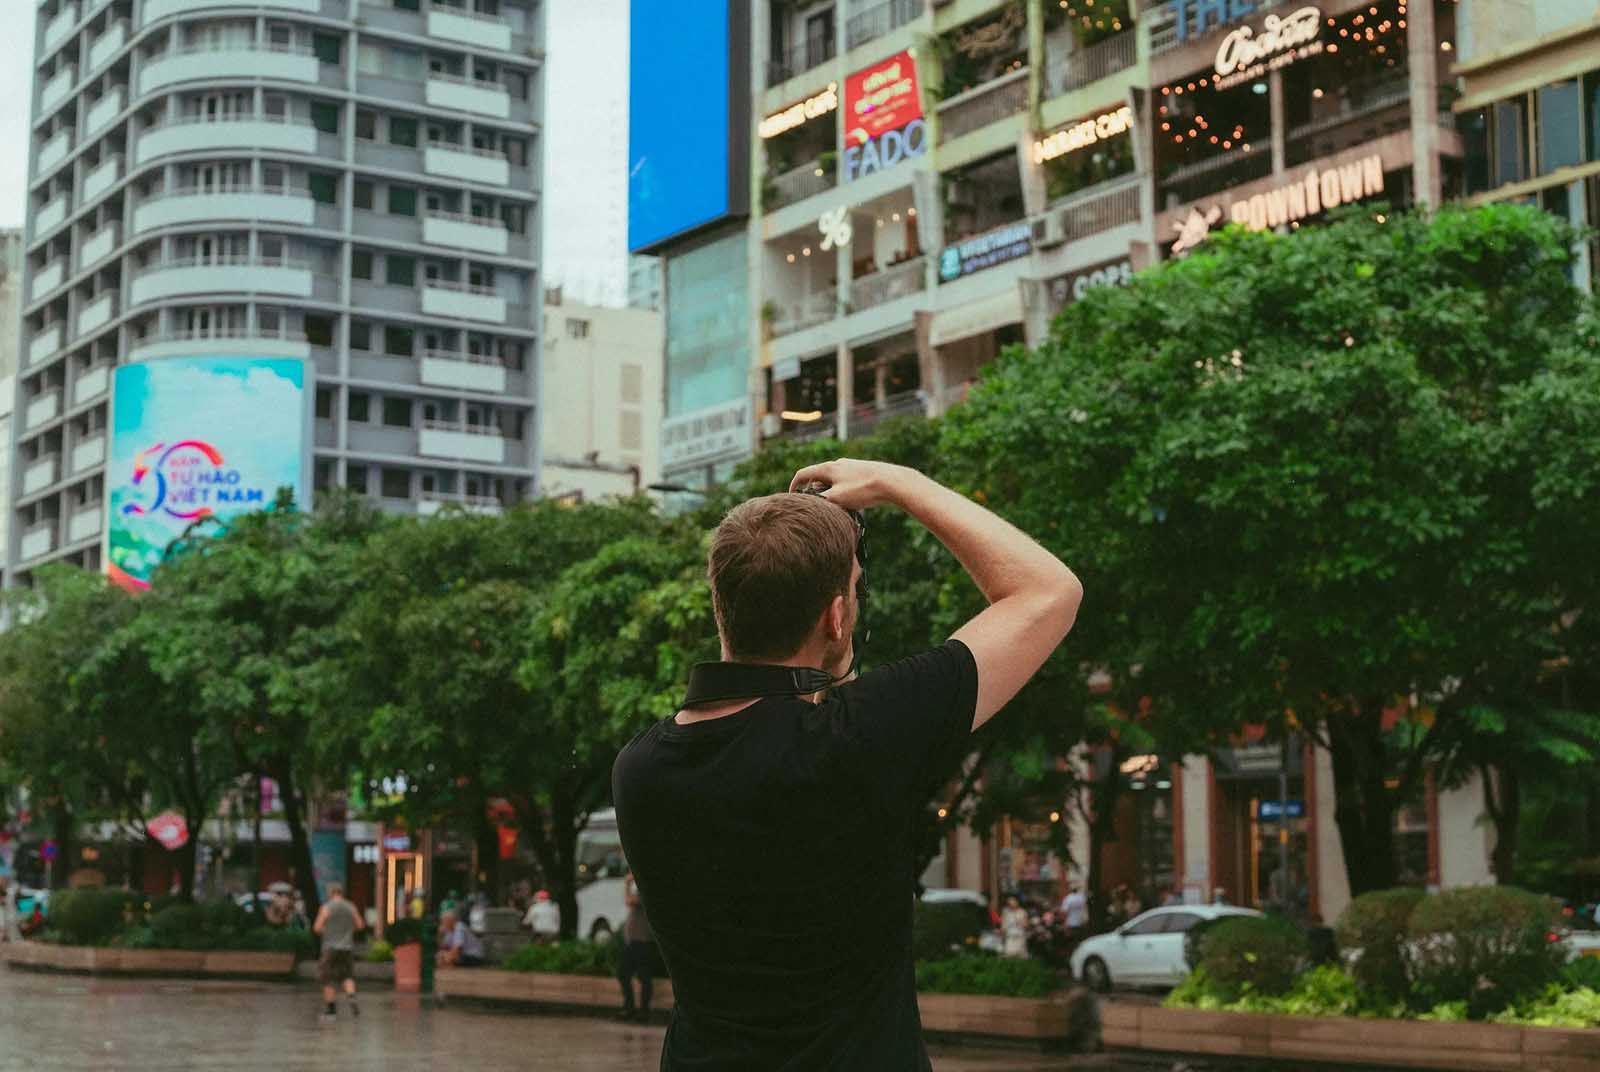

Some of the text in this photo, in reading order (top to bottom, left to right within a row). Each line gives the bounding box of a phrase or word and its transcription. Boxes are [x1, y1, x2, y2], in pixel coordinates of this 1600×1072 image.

[844, 119, 926, 184] FADO
[1231, 154, 1384, 231] DOWNTOWN
[217, 489, 264, 502] NAM
